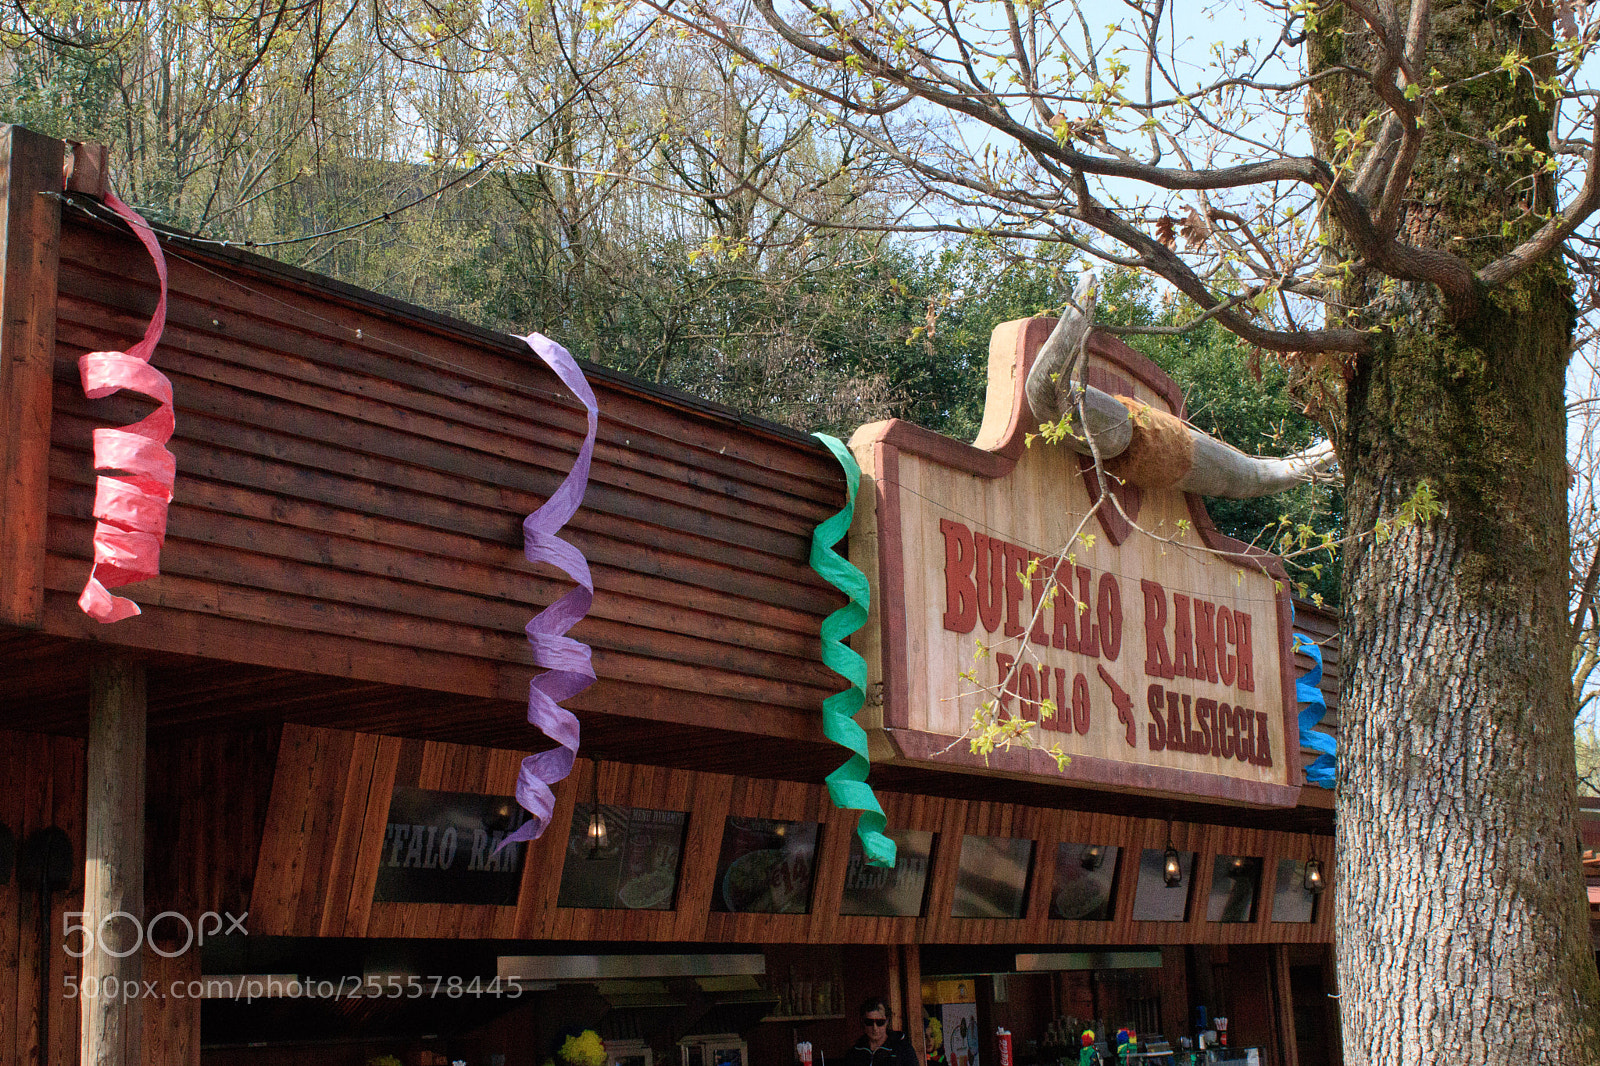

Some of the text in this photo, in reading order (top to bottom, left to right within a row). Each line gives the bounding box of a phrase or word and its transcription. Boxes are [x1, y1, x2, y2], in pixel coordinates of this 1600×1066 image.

[940, 518, 1255, 692] BUFFALO RANCH
[996, 652, 1091, 736] POLLO
[1147, 683, 1273, 767] SALSICCIA
